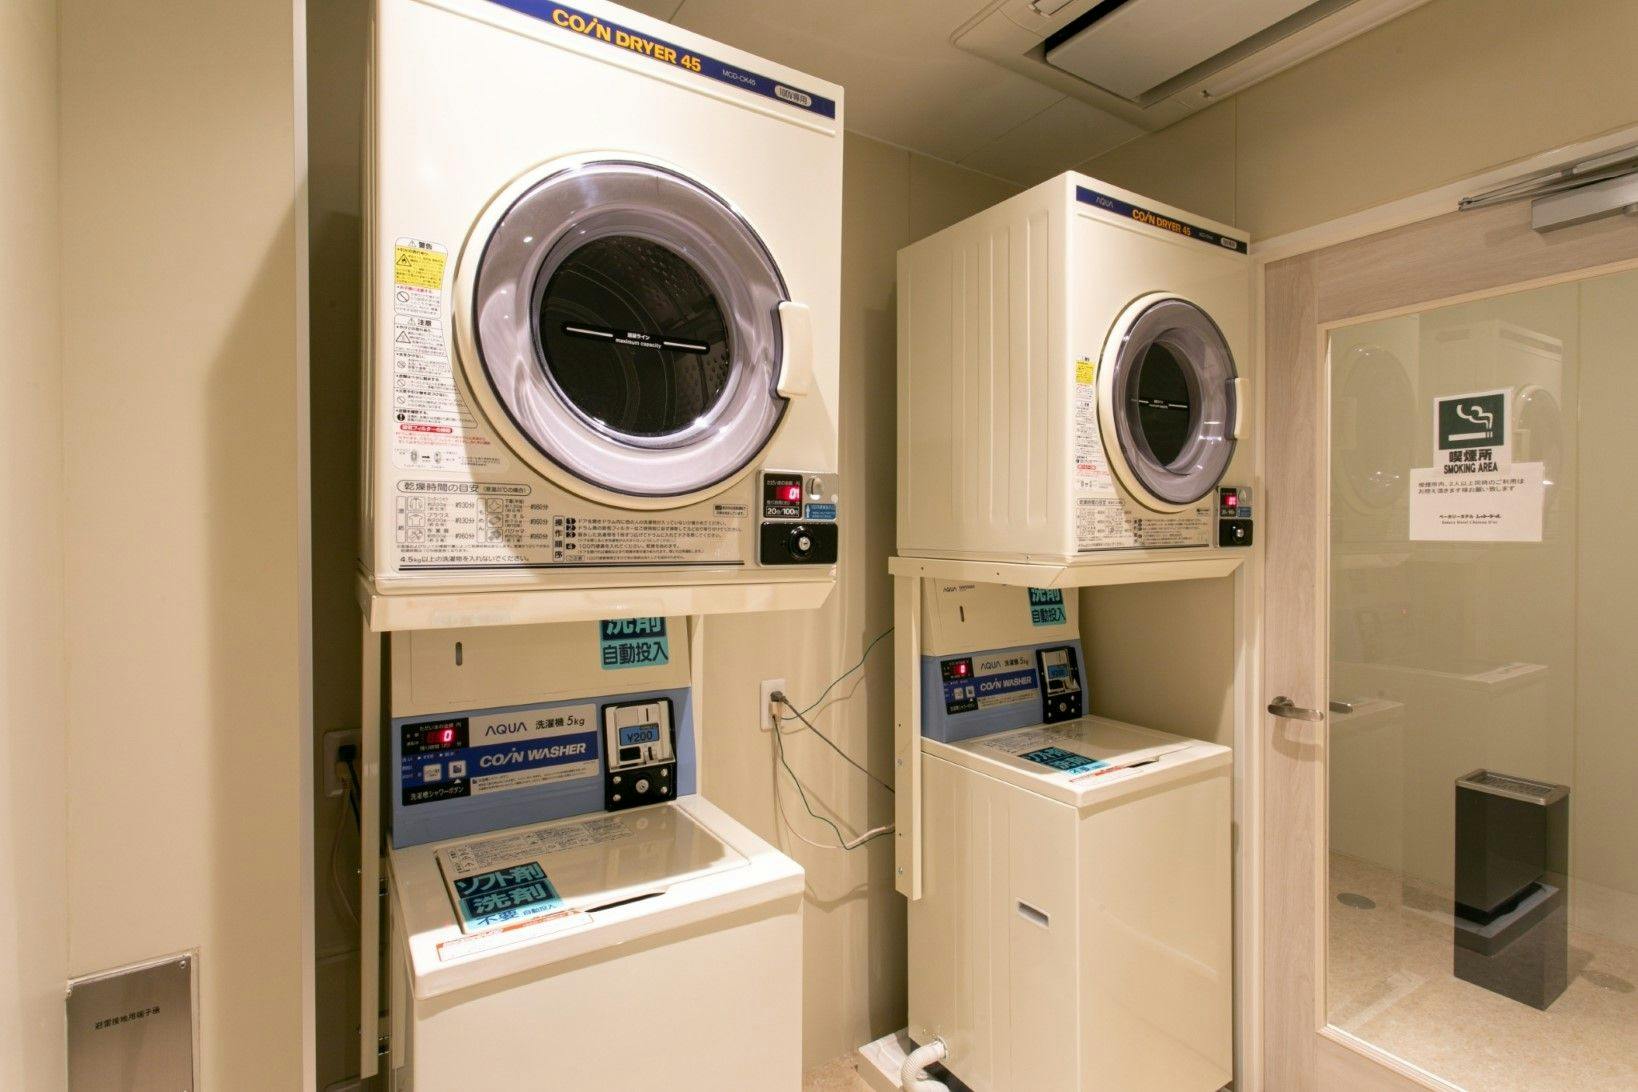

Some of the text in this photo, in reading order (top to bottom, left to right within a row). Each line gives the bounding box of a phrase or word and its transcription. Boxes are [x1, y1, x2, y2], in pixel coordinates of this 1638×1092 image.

[552, 8, 702, 73] COIN DRYER 45
[1132, 209, 1191, 236] COIN DRYER 45
[1449, 448, 1492, 462] 喫煙所
[1444, 461, 1498, 475] SMOKING AREA
[602, 641, 669, 666] 自動投入
[980, 661, 1001, 671] AQUA
[980, 675, 1032, 692] COIN WASHER
[443, 729, 453, 742] 0
[485, 715, 586, 737] AQUA 洗濯機 5kg
[480, 747, 526, 769] COIN
[527, 742, 587, 761] WASHER
[457, 865, 544, 895] ソフト剤
[473, 883, 547, 914] 洗剤
[477, 909, 519, 926] 不要
